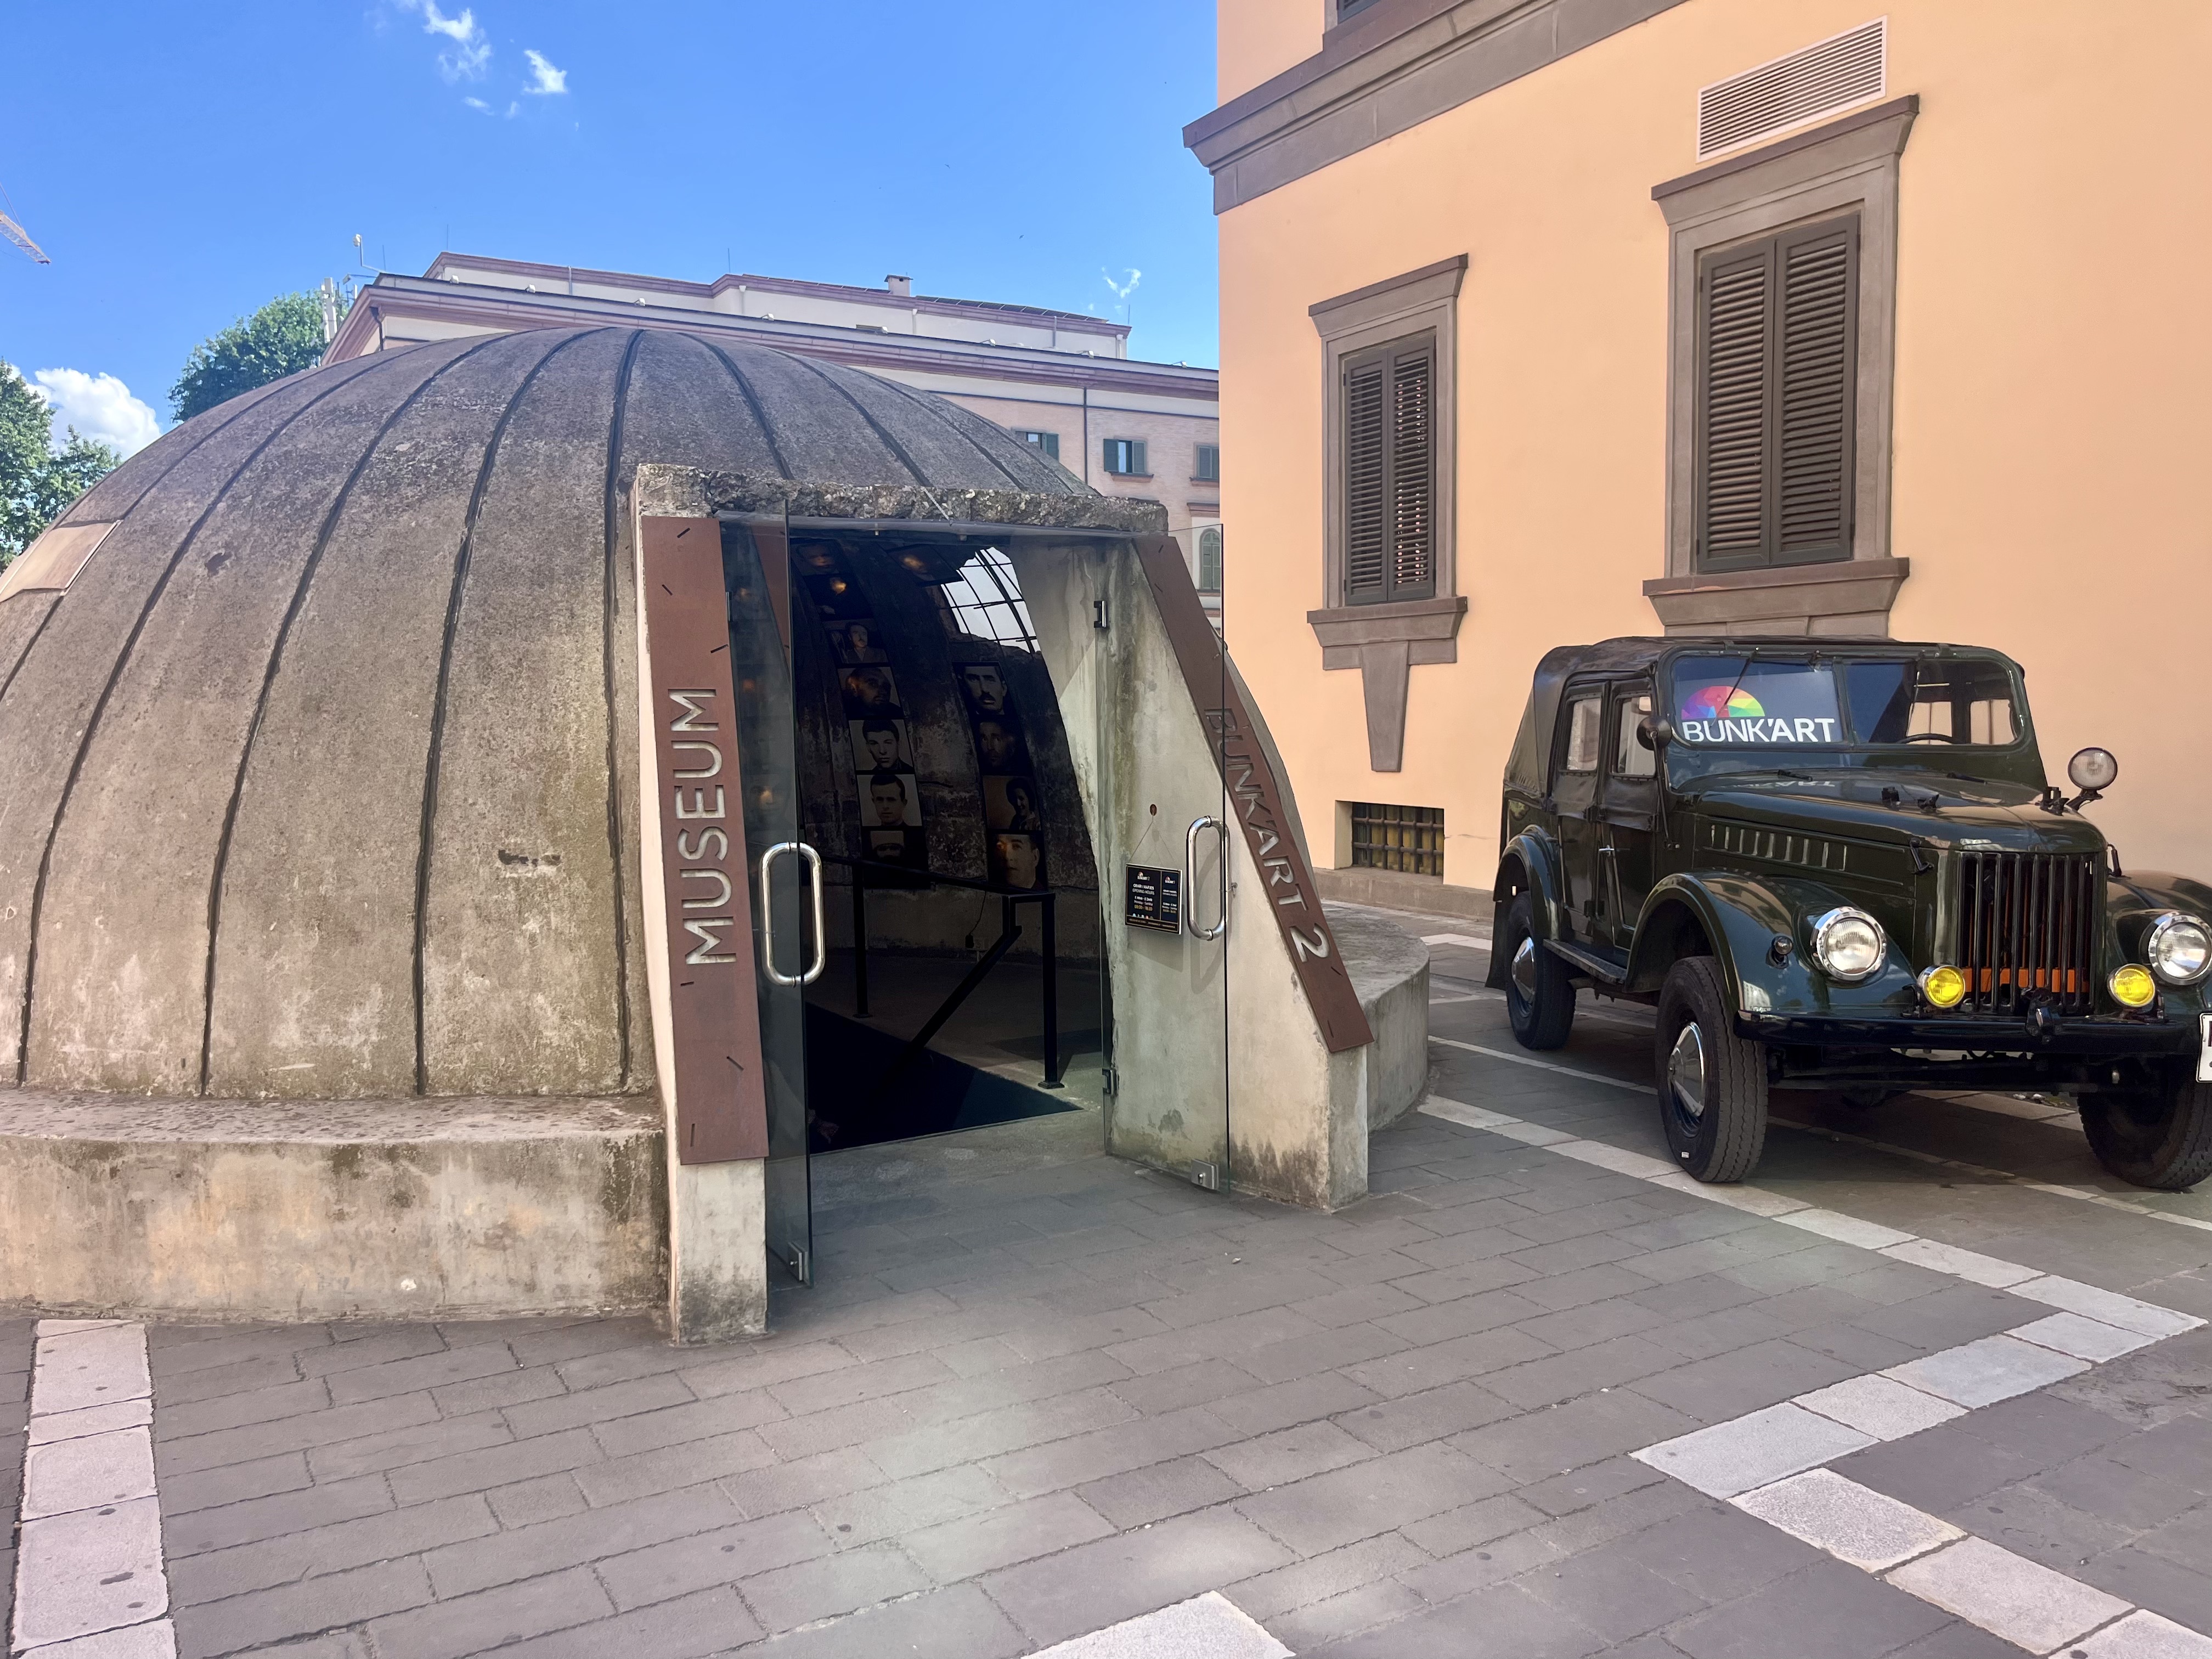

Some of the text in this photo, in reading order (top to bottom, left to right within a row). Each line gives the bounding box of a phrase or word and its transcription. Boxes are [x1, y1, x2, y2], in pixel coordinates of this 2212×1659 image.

[668, 689, 737, 964] MUSEUM
[1204, 708, 1330, 963] BUNK'ART 2
[1682, 718, 1835, 742] BUNK'ART
